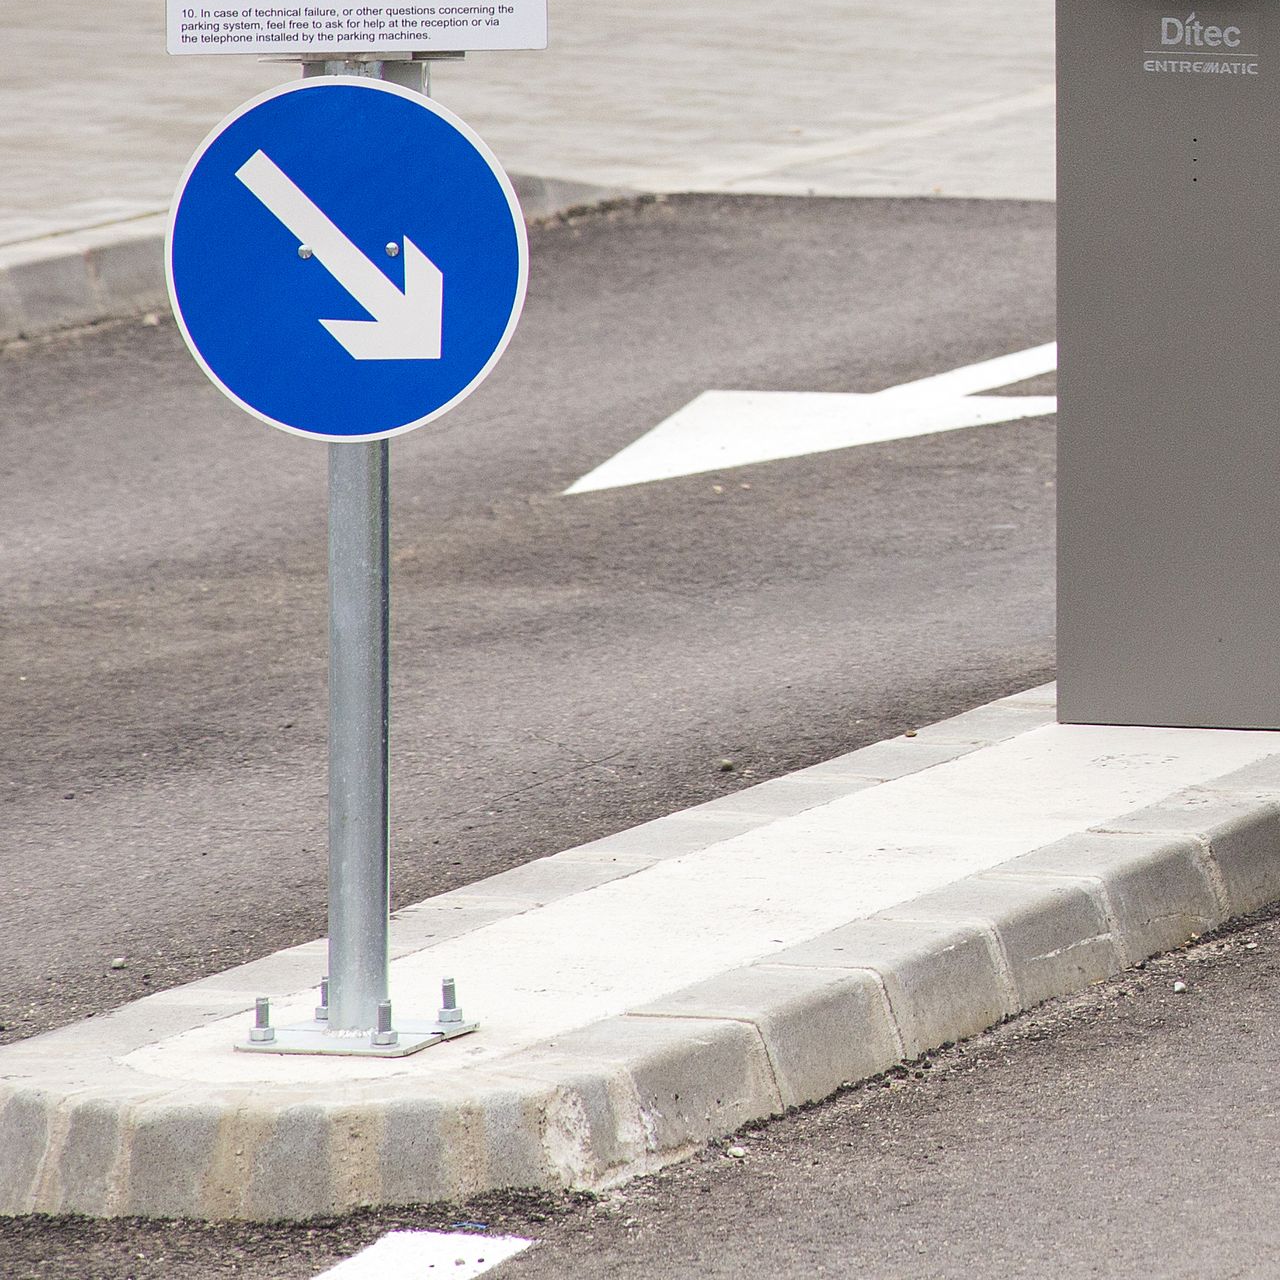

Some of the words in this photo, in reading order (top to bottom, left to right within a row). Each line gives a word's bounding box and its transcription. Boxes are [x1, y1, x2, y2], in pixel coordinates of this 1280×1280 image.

[181, 31, 198, 43] the
[200, 30, 253, 44] telephone
[255, 32, 299, 42] installed
[301, 32, 314, 43] by
[317, 32, 334, 41] the
[336, 31, 375, 43] parking
[378, 30, 431, 40] machines.
[1143, 60, 1259, 75] ENTREMATIC
